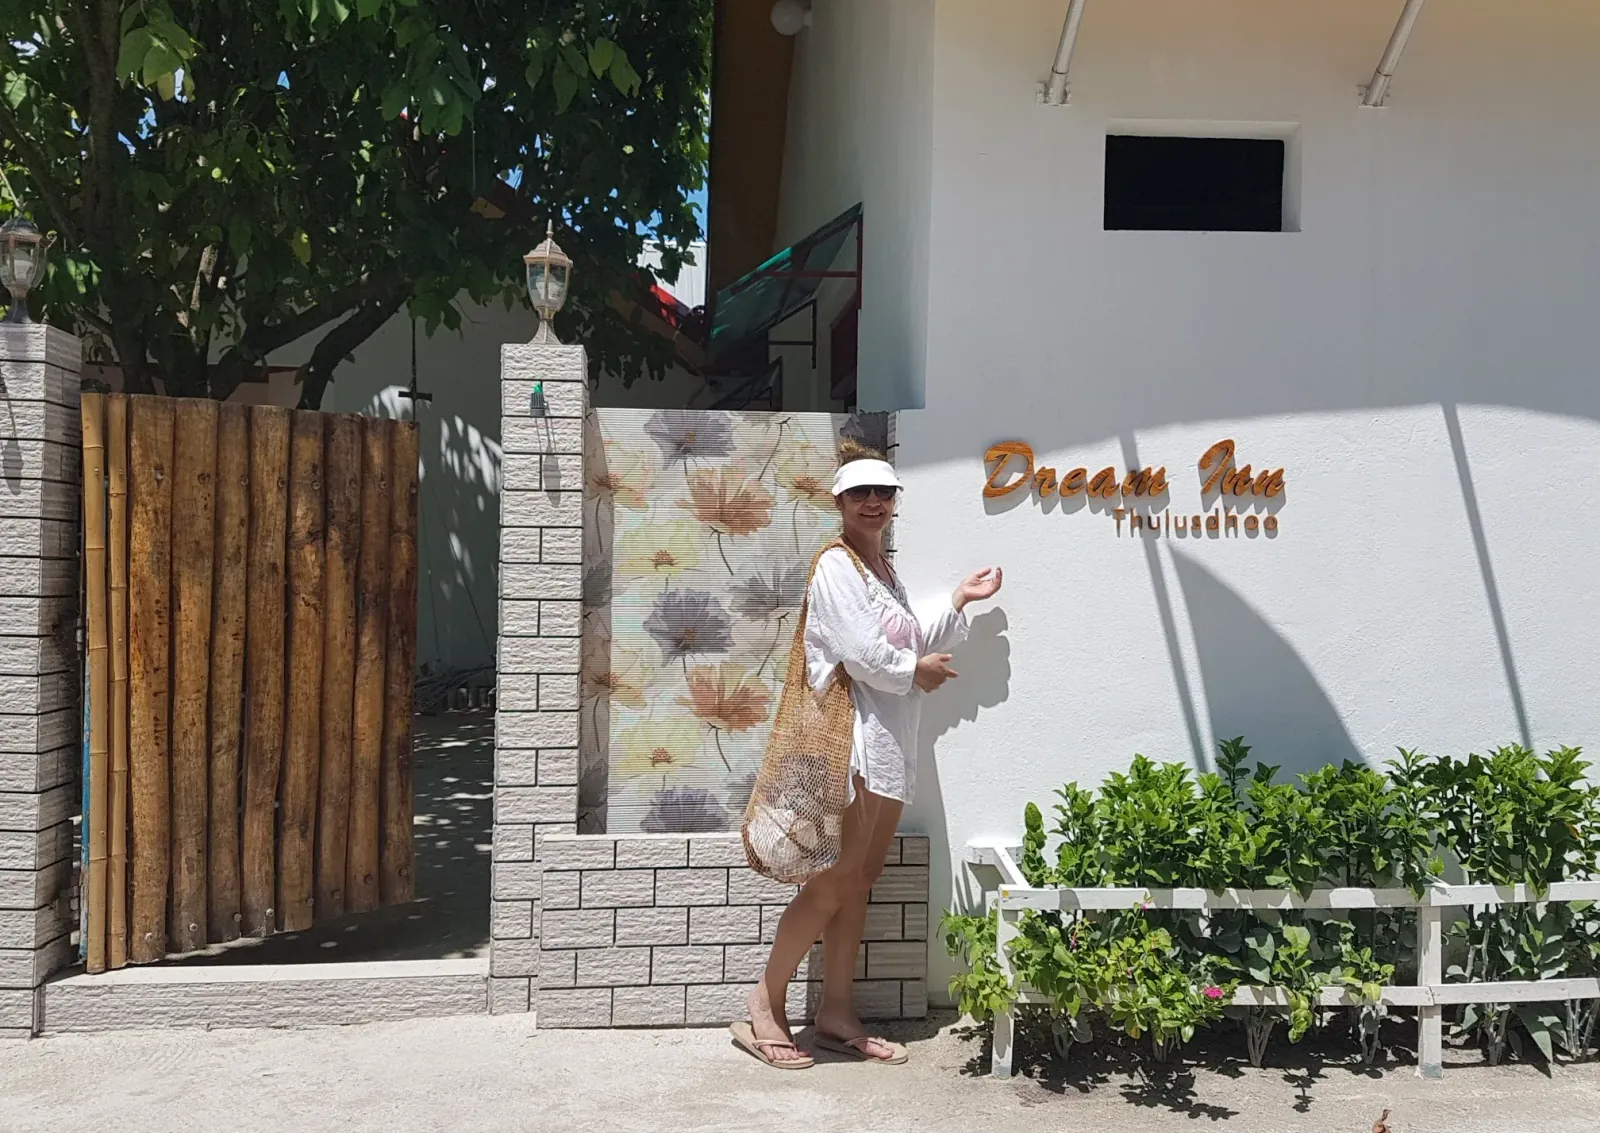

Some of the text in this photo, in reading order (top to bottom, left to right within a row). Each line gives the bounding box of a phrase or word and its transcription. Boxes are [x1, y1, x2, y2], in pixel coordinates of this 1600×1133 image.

[982, 438, 1286, 498] Dream Inn
[1112, 507, 1279, 532] Thulusdhoo
